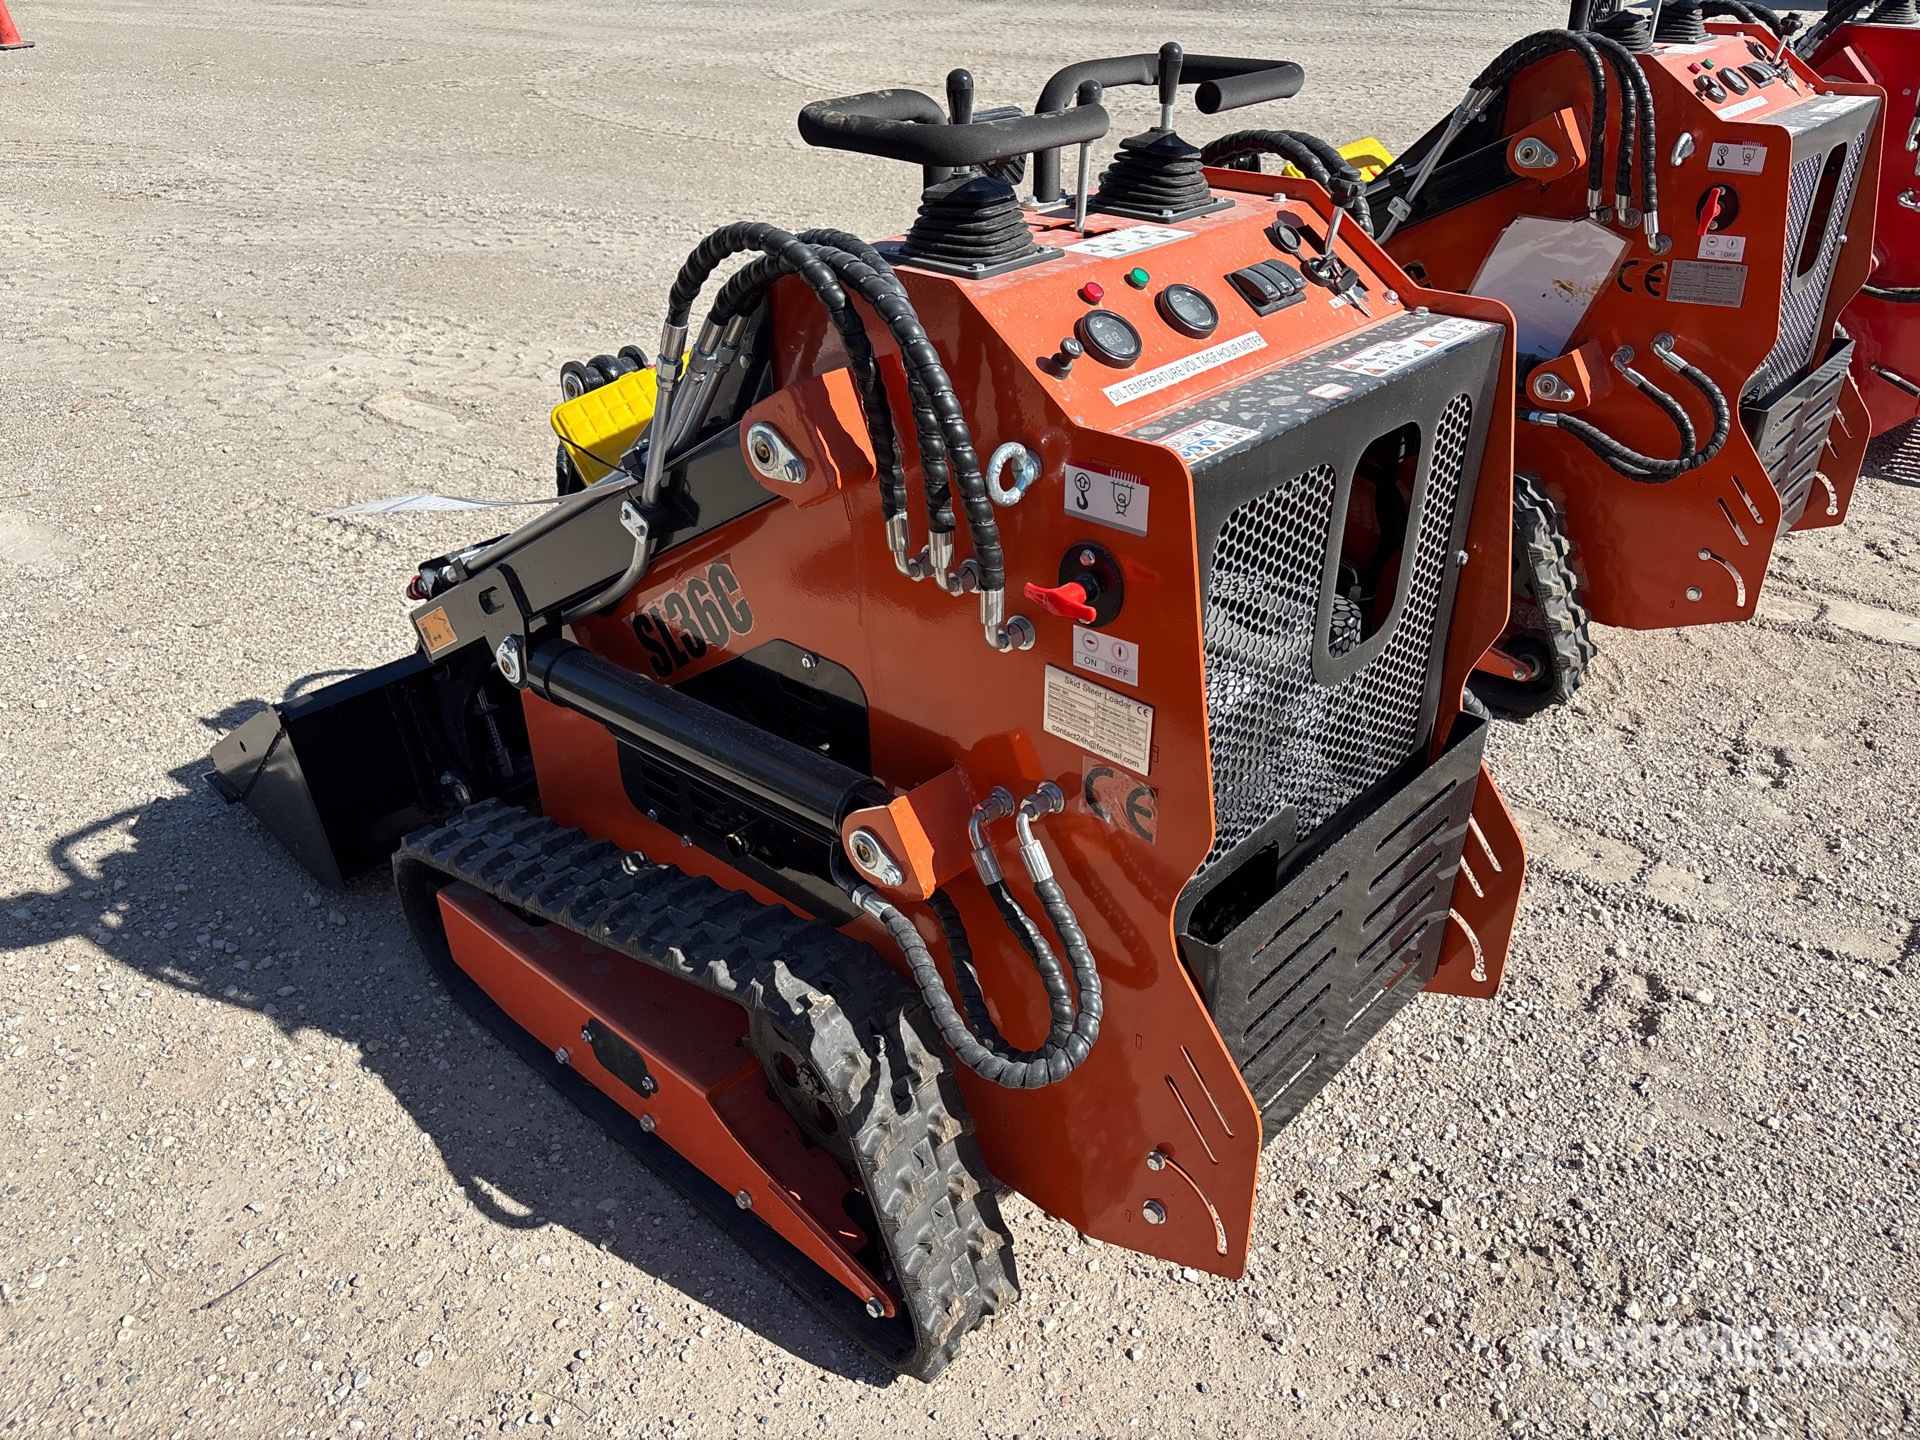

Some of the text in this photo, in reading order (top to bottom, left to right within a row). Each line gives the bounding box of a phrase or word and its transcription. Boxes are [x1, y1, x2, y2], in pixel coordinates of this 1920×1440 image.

[1108, 334, 1265, 402] OIL TEMPERATURE VOLTAGE HOUR METER
[631, 563, 754, 678] SL36C
[1083, 656, 1129, 677] ON OFF
[1064, 675, 1081, 689] Skid
[1082, 683, 1103, 698] Steer
[1104, 692, 1132, 710] Loader
[1051, 723, 1139, 769] contact24h@foxmail.com
